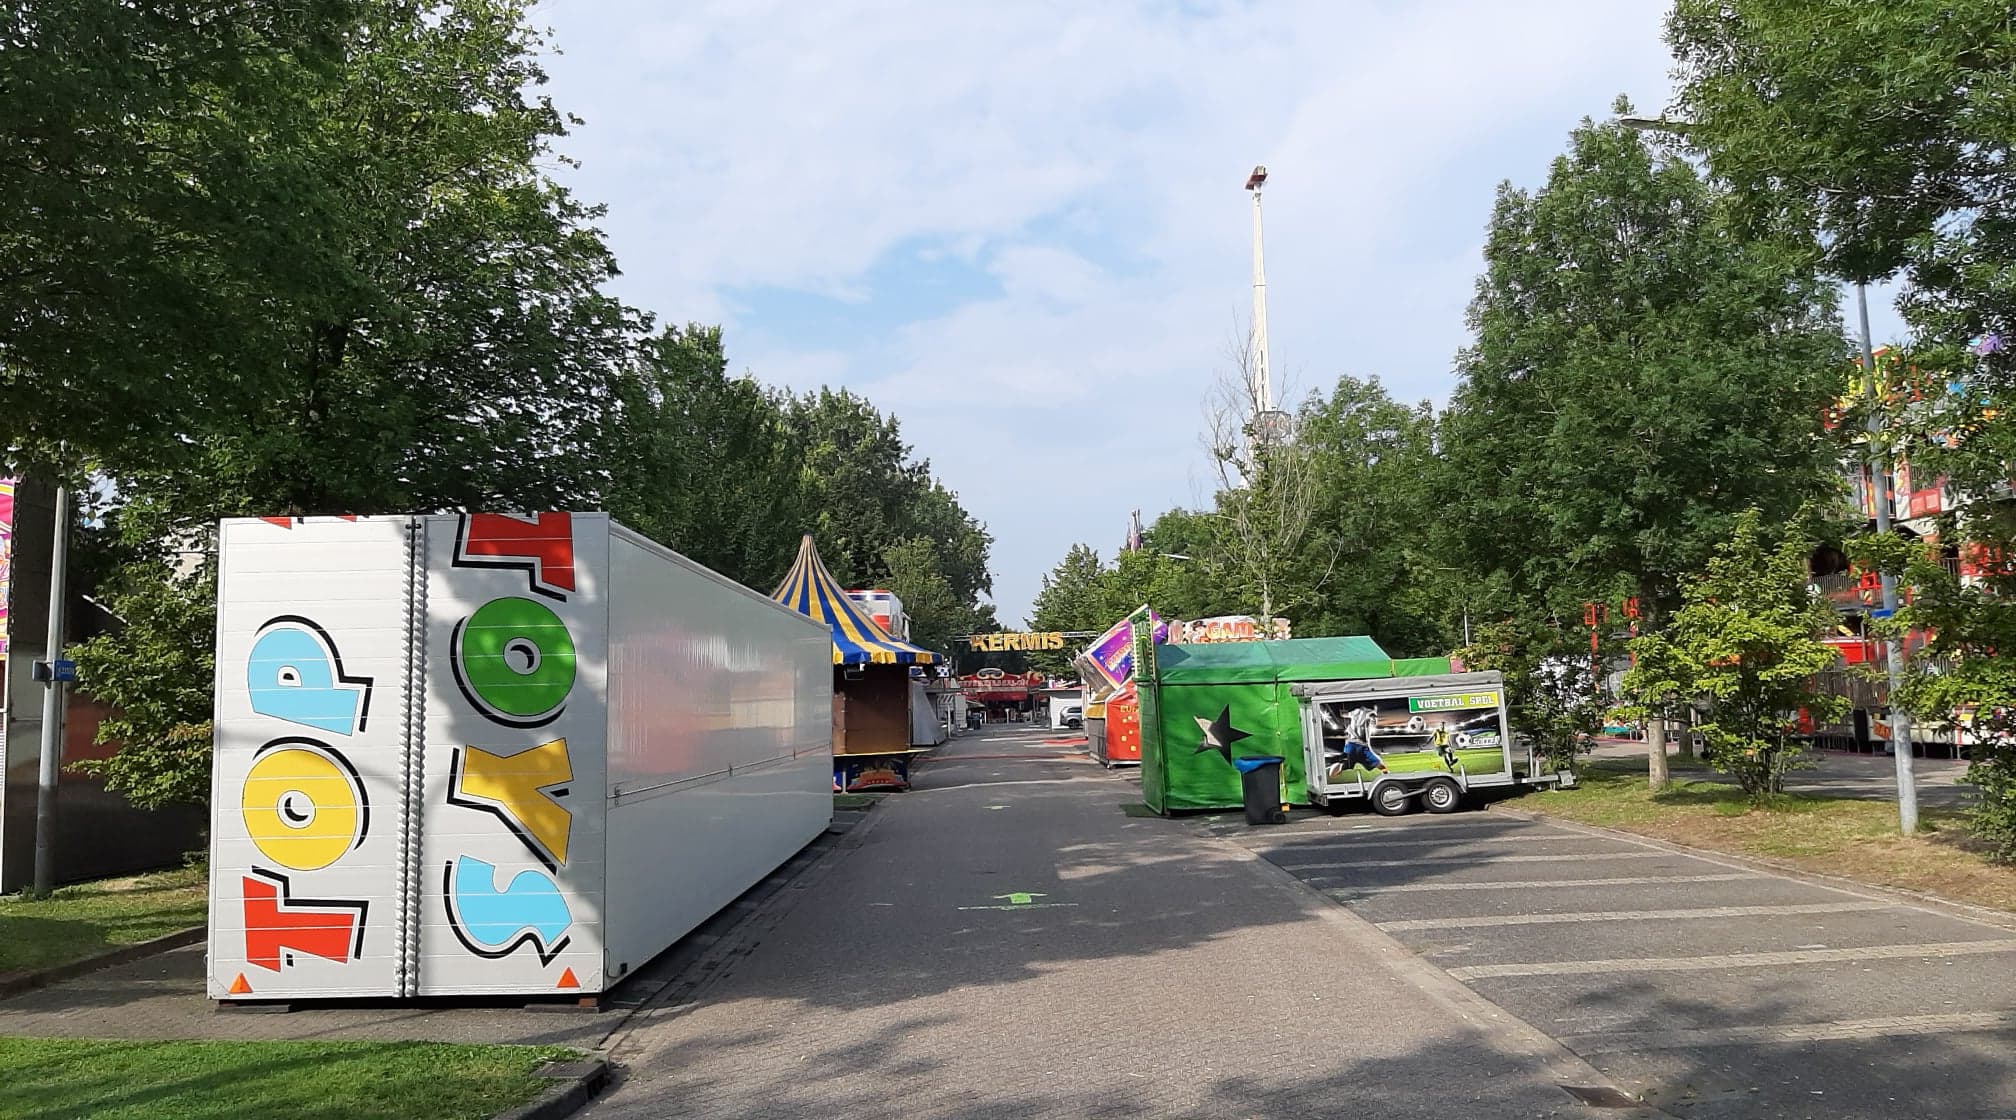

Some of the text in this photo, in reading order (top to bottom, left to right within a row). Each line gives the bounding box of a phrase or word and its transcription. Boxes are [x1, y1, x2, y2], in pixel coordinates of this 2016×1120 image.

[970, 631, 1064, 652] KERMIS
[1417, 697, 1465, 709] VOETBAL
[242, 614, 374, 973] TOP
